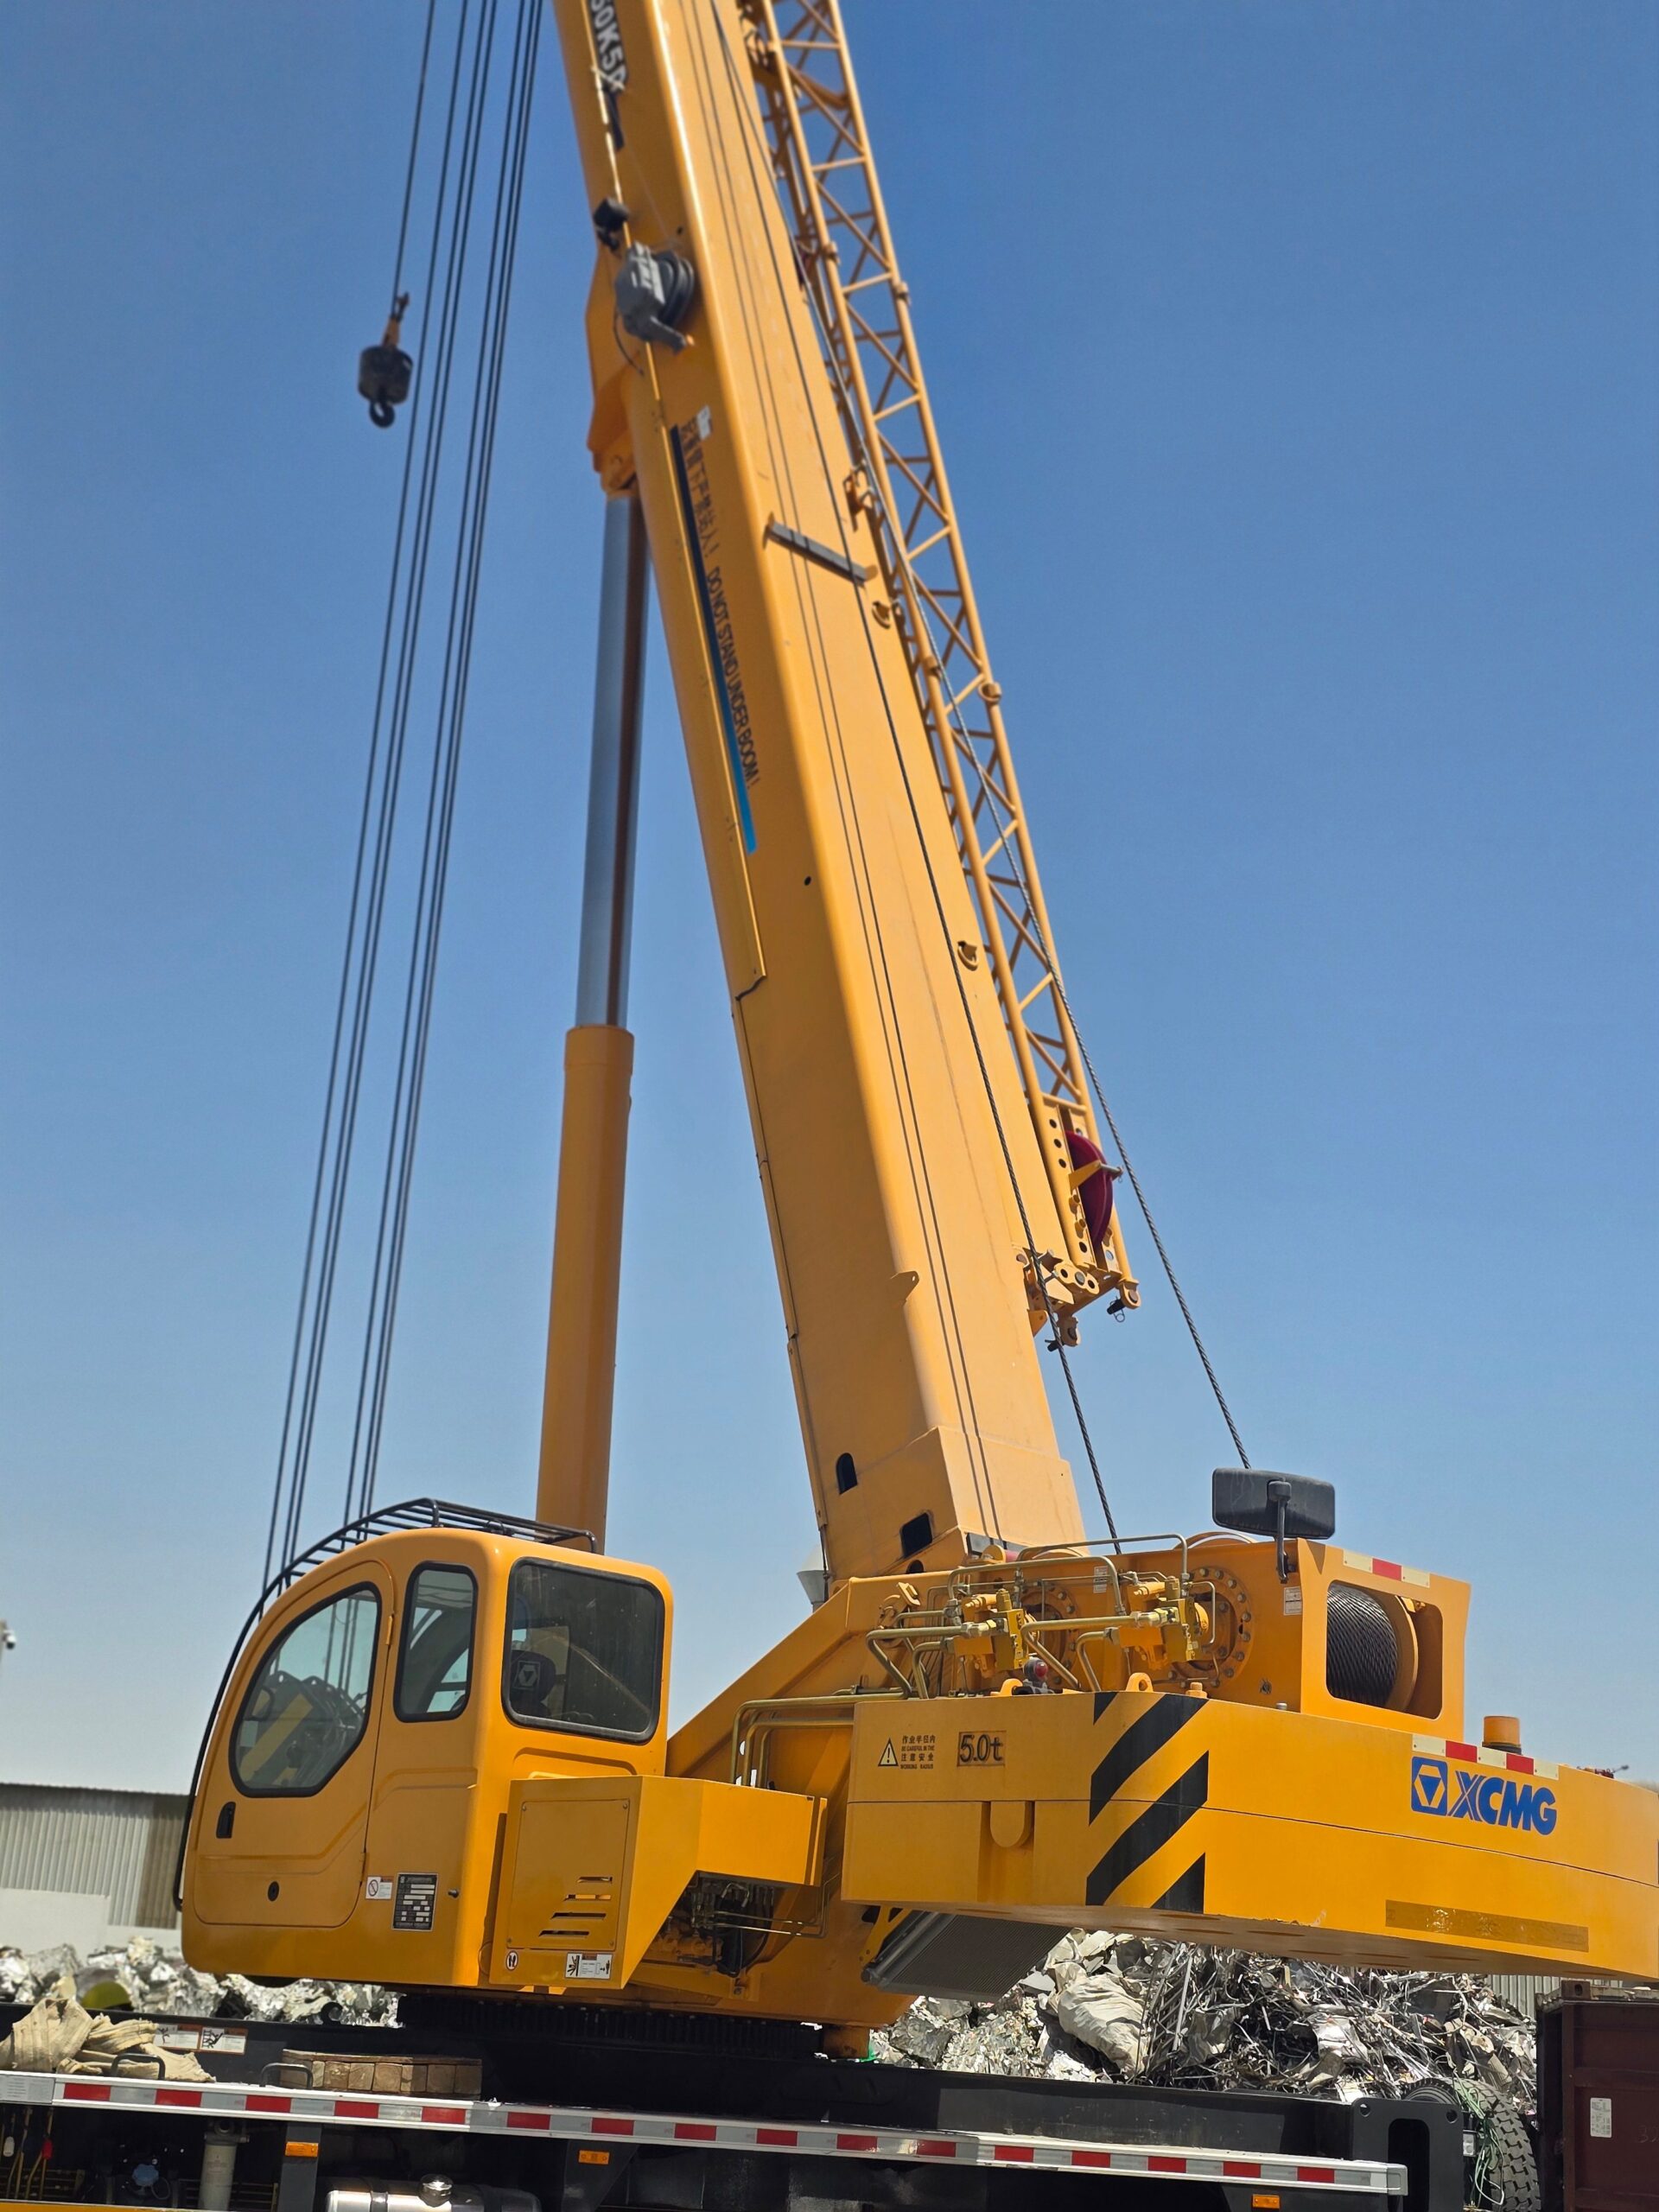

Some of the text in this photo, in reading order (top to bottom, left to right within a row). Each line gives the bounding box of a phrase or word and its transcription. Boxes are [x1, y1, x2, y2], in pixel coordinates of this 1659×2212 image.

[708, 566, 722, 593] DO
[712, 590, 729, 624] NOT
[718, 622, 739, 676] STAND
[727, 671, 749, 734] UNDER
[960, 1734, 1003, 1762] 5.0t
[1447, 1770, 1557, 1835] XCMG
